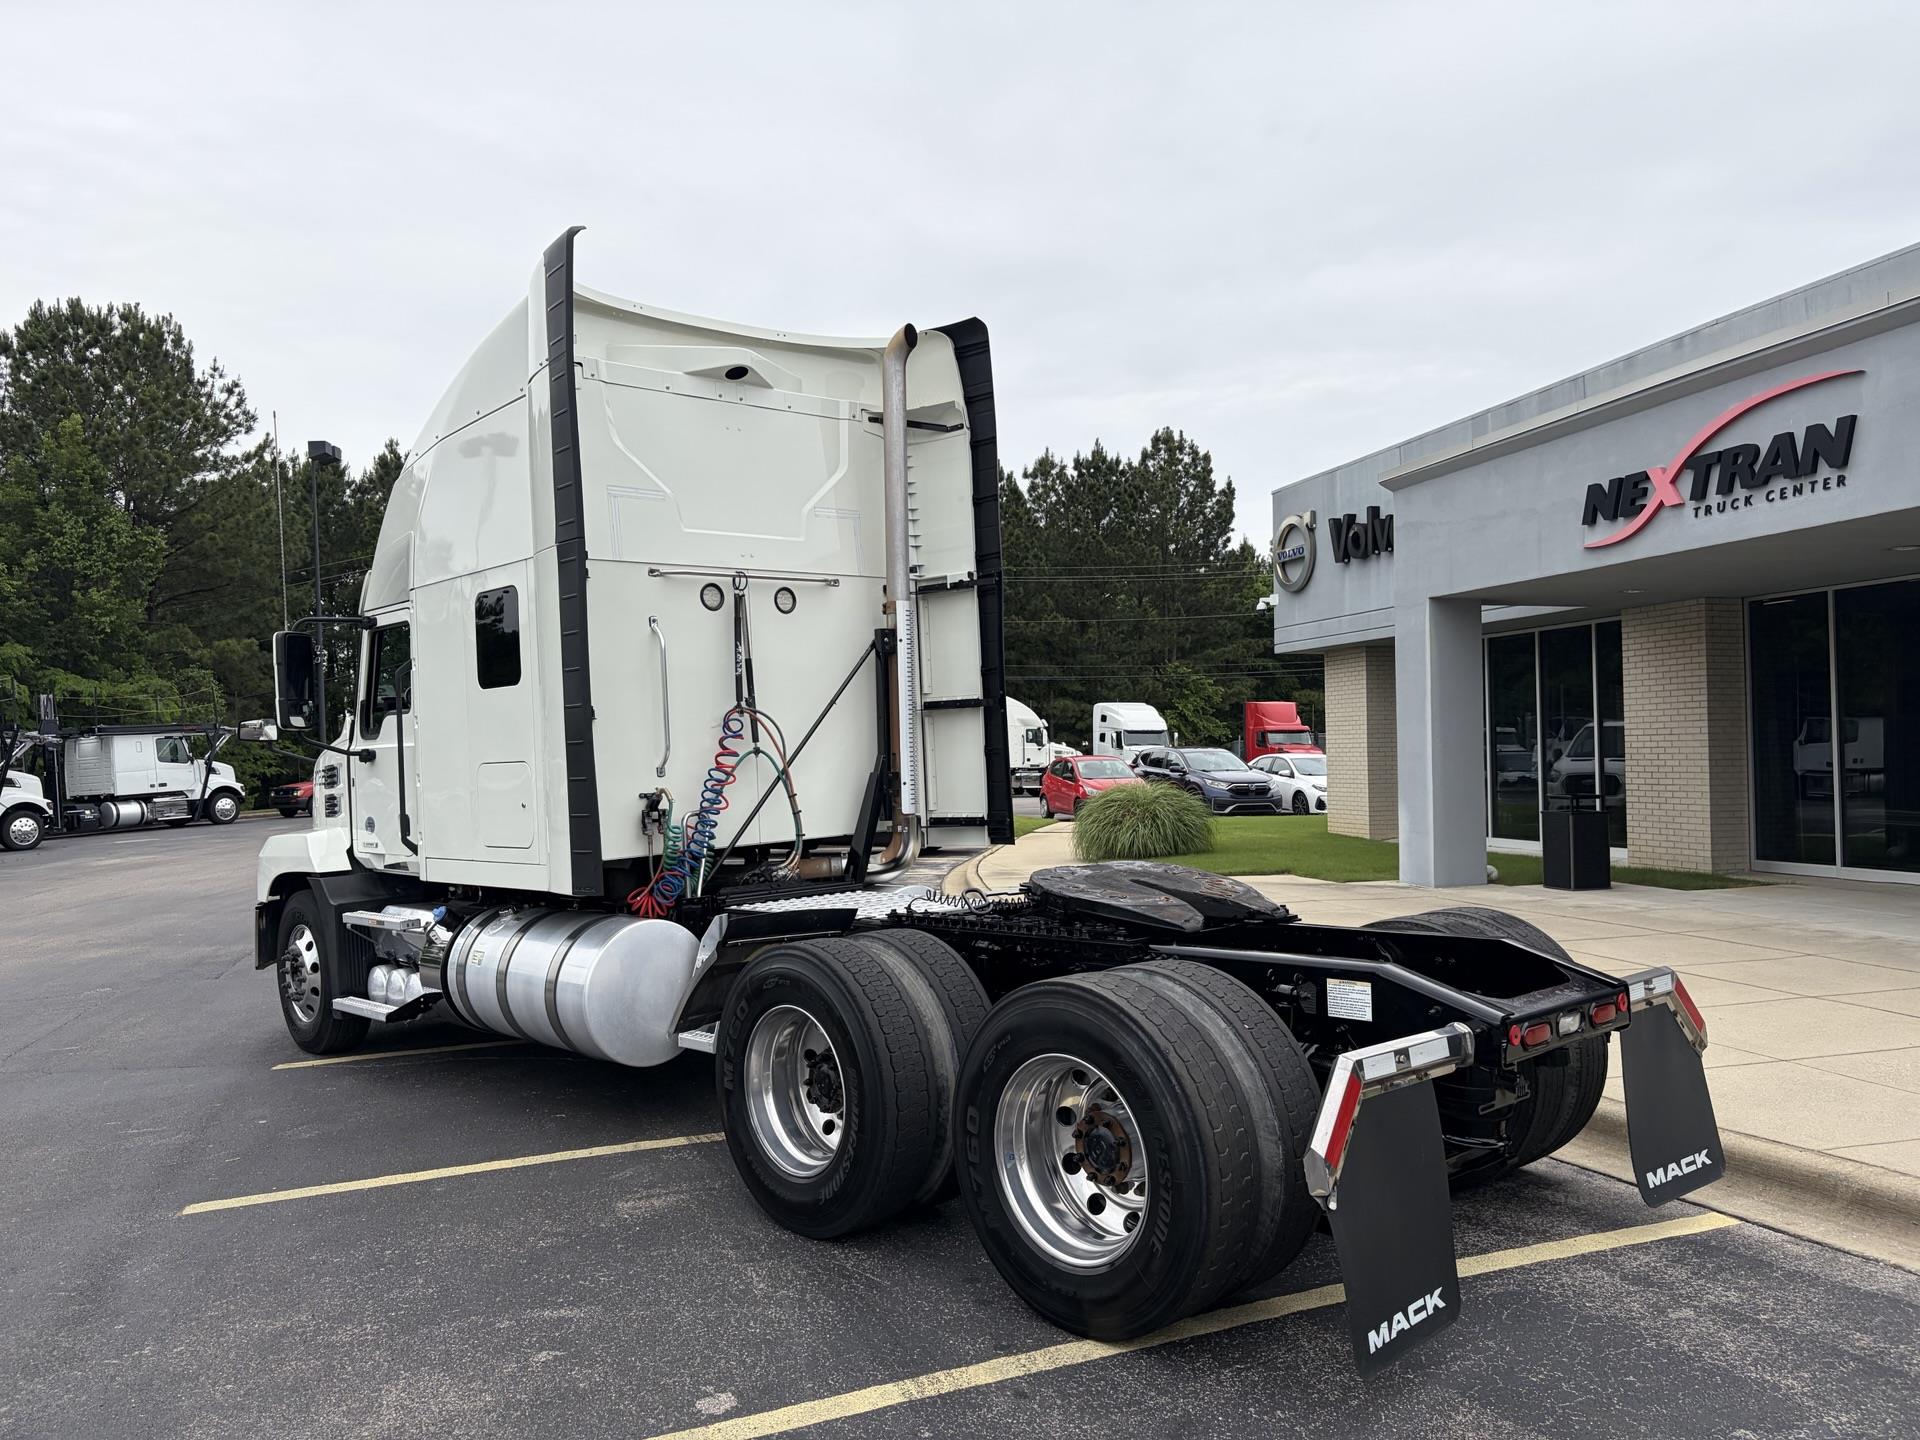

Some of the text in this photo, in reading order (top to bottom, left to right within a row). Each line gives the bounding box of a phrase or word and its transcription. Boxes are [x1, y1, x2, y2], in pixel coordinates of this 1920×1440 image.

[1582, 414, 1858, 526] NEXTRAN
[1693, 474, 1847, 518] TRUCK CENTER
[1277, 546, 1305, 561] VOLVO
[1646, 1148, 1713, 1189] MACK
[1367, 1286, 1447, 1355] MACK
